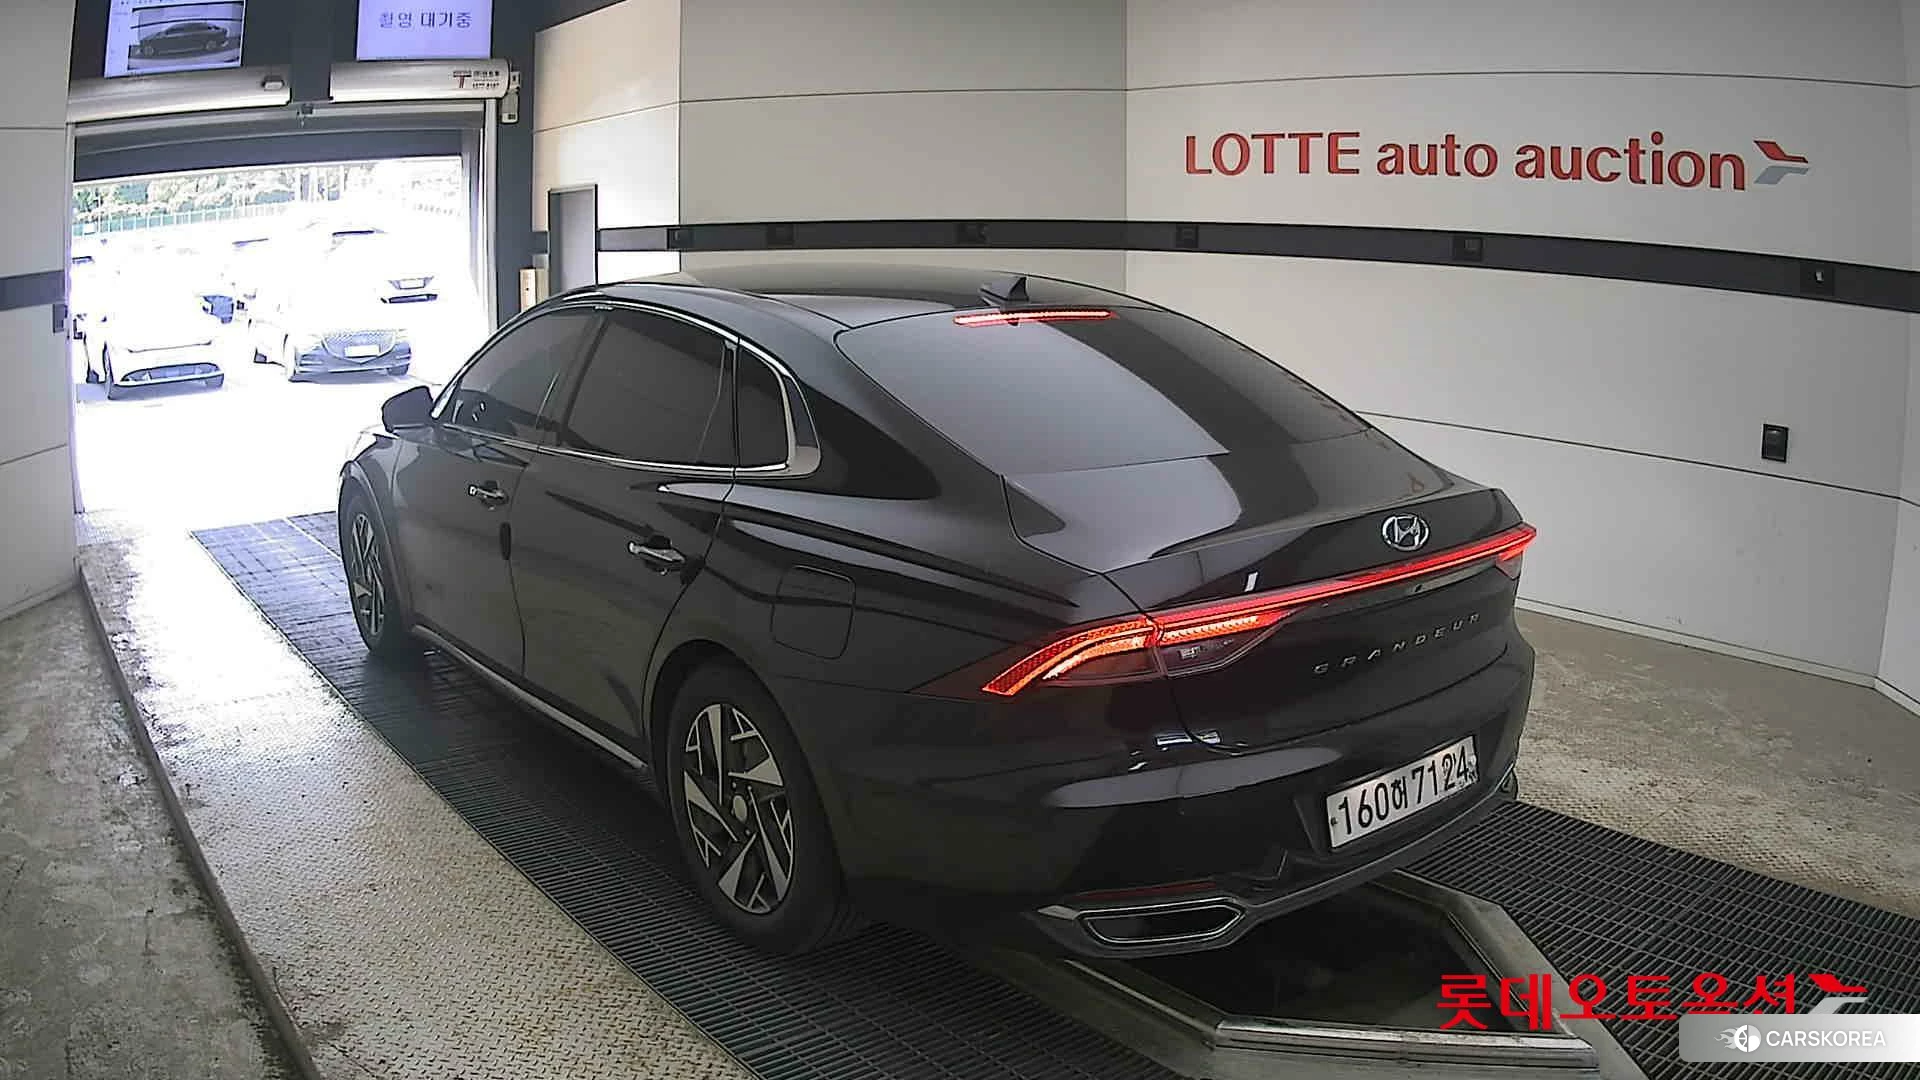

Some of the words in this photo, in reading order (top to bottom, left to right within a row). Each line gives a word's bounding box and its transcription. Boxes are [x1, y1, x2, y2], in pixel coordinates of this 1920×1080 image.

[421, 11, 472, 28] 대기중
[1185, 131, 1361, 176] LOTTE
[1376, 133, 1498, 178] auto
[1514, 131, 1746, 191] auction
[1313, 612, 1480, 675] GRANDEUR
